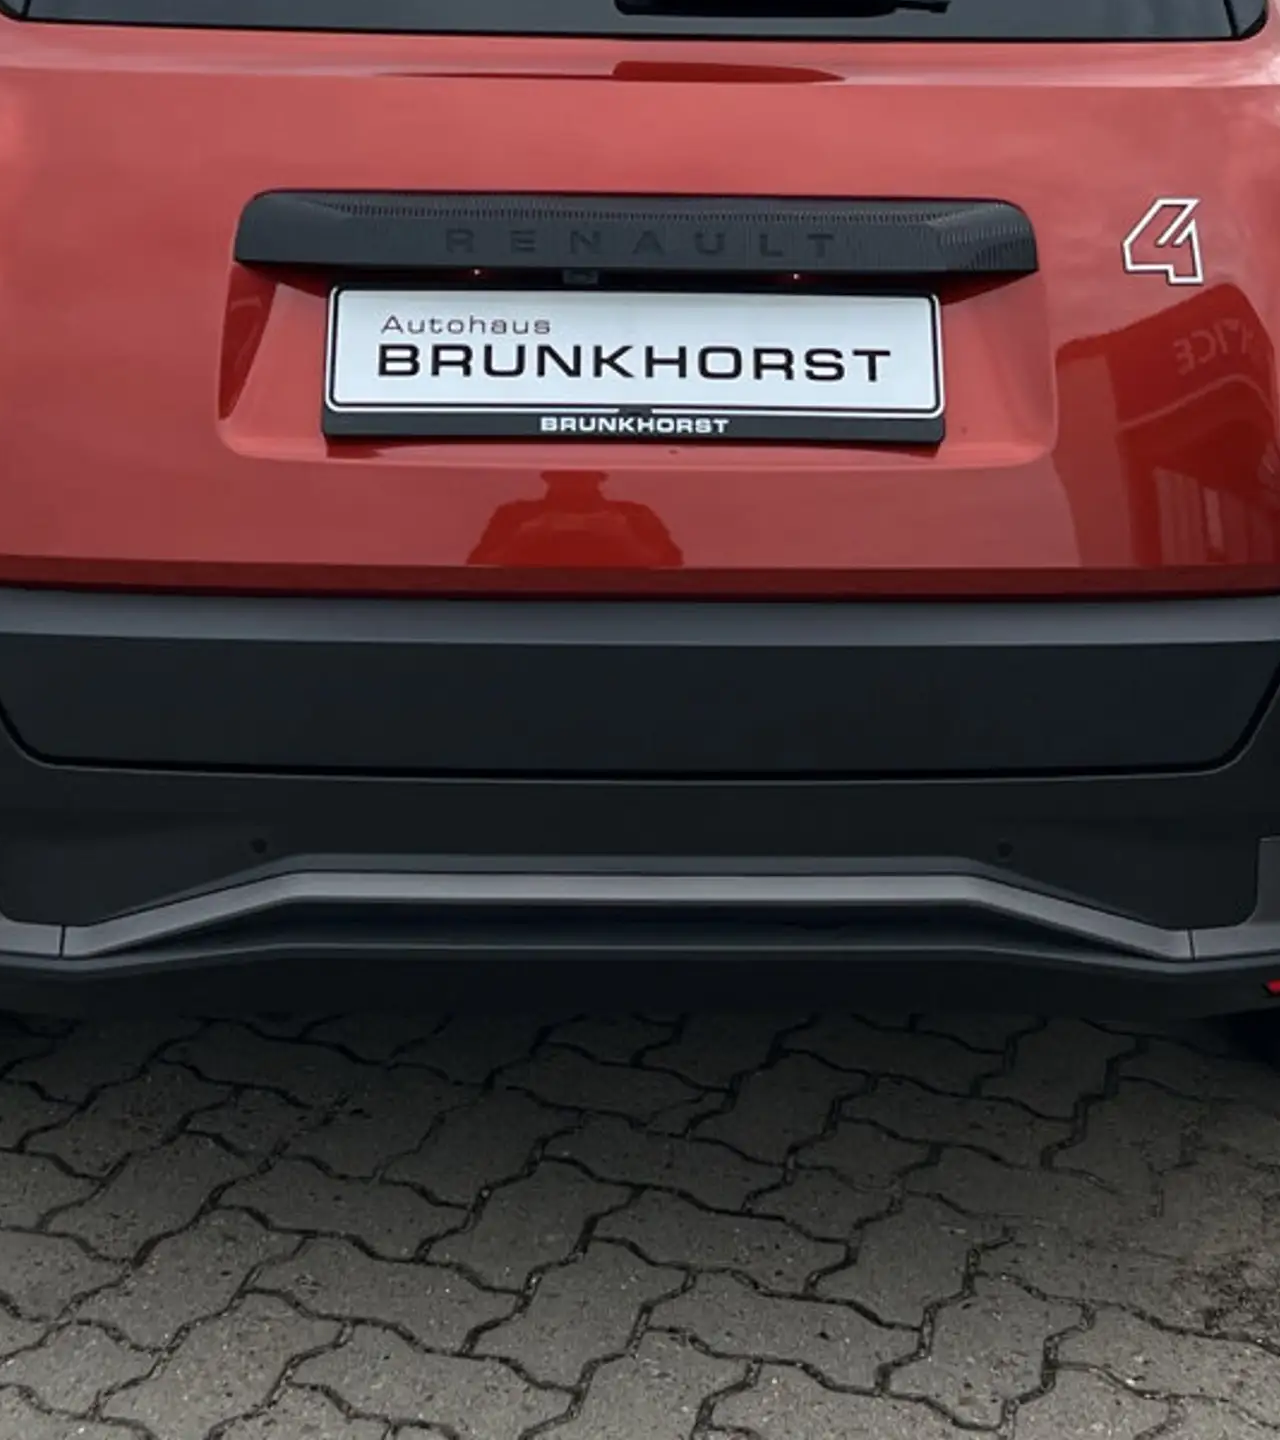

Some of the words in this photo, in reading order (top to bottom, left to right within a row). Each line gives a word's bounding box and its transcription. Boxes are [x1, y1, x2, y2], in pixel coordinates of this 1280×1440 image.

[445, 228, 837, 255] RENAULT
[1122, 197, 1203, 284] 4
[381, 314, 552, 336] Autohaus
[377, 343, 891, 383] BRUNKHORST
[539, 416, 730, 435] BRUNKHORST
